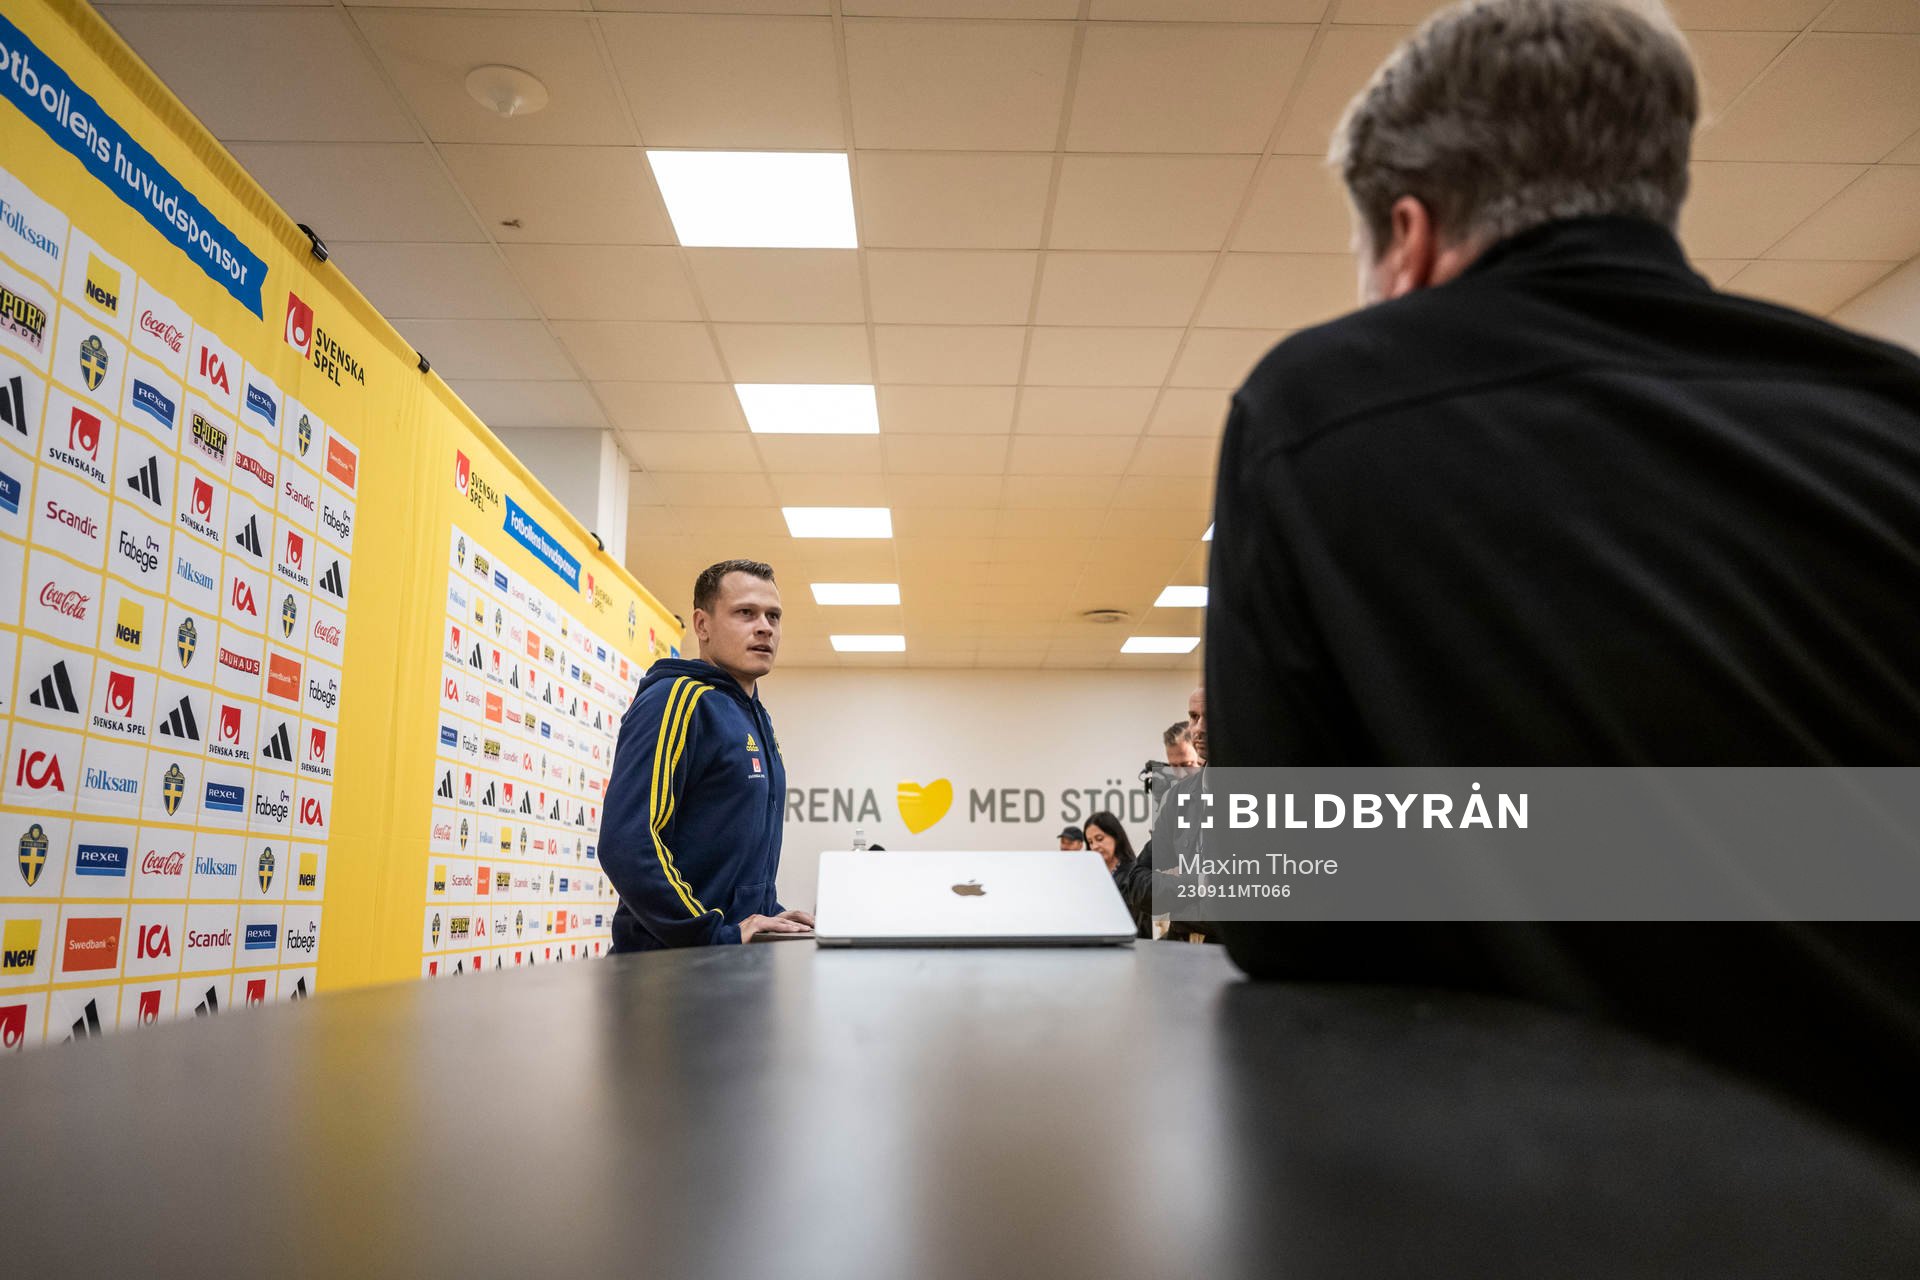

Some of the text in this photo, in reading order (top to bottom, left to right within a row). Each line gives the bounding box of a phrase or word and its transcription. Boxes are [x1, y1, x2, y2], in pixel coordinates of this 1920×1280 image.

[0, 199, 58, 260] Folksam
[114, 141, 248, 285] huvudsponsor
[0, 285, 46, 340] PORT
[140, 310, 185, 353] Coca-Cola
[200, 346, 230, 395] ICA
[314, 350, 341, 387] SPEL
[316, 328, 365, 386] SVENSKA
[50, 448, 106, 484] SVENSKA SPEL
[470, 488, 484, 512] SPEL
[471, 472, 498, 507] SVENSKA
[46, 501, 98, 539] Scandic
[206, 527, 219, 542] SPEL
[323, 505, 349, 539] Fabege
[119, 531, 158, 572] Fabege
[177, 557, 213, 590] Folksam
[298, 574, 309, 587] SPEL
[40, 582, 90, 620] Coca-Cola
[232, 577, 257, 616] ICA
[220, 650, 260, 674] BAUHAUS
[309, 680, 336, 709] Fabege
[93, 715, 146, 736] SVENSKA SPEL
[209, 744, 250, 760] SVENSKA SPEL
[16, 748, 65, 792] ICA
[85, 767, 138, 794] Folksam
[301, 762, 331, 777] SVENSKA SPEL
[256, 794, 288, 822] Fabege
[300, 797, 323, 827] ICA
[969, 788, 1046, 823] MED
[1061, 779, 1149, 823] STÖD
[141, 849, 186, 876] Coca-Cola
[195, 856, 237, 876] Folksam
[69, 938, 106, 951] Swedbank
[137, 924, 171, 959] ICA
[188, 929, 231, 948] Scandic
[287, 930, 315, 953] Fabege
